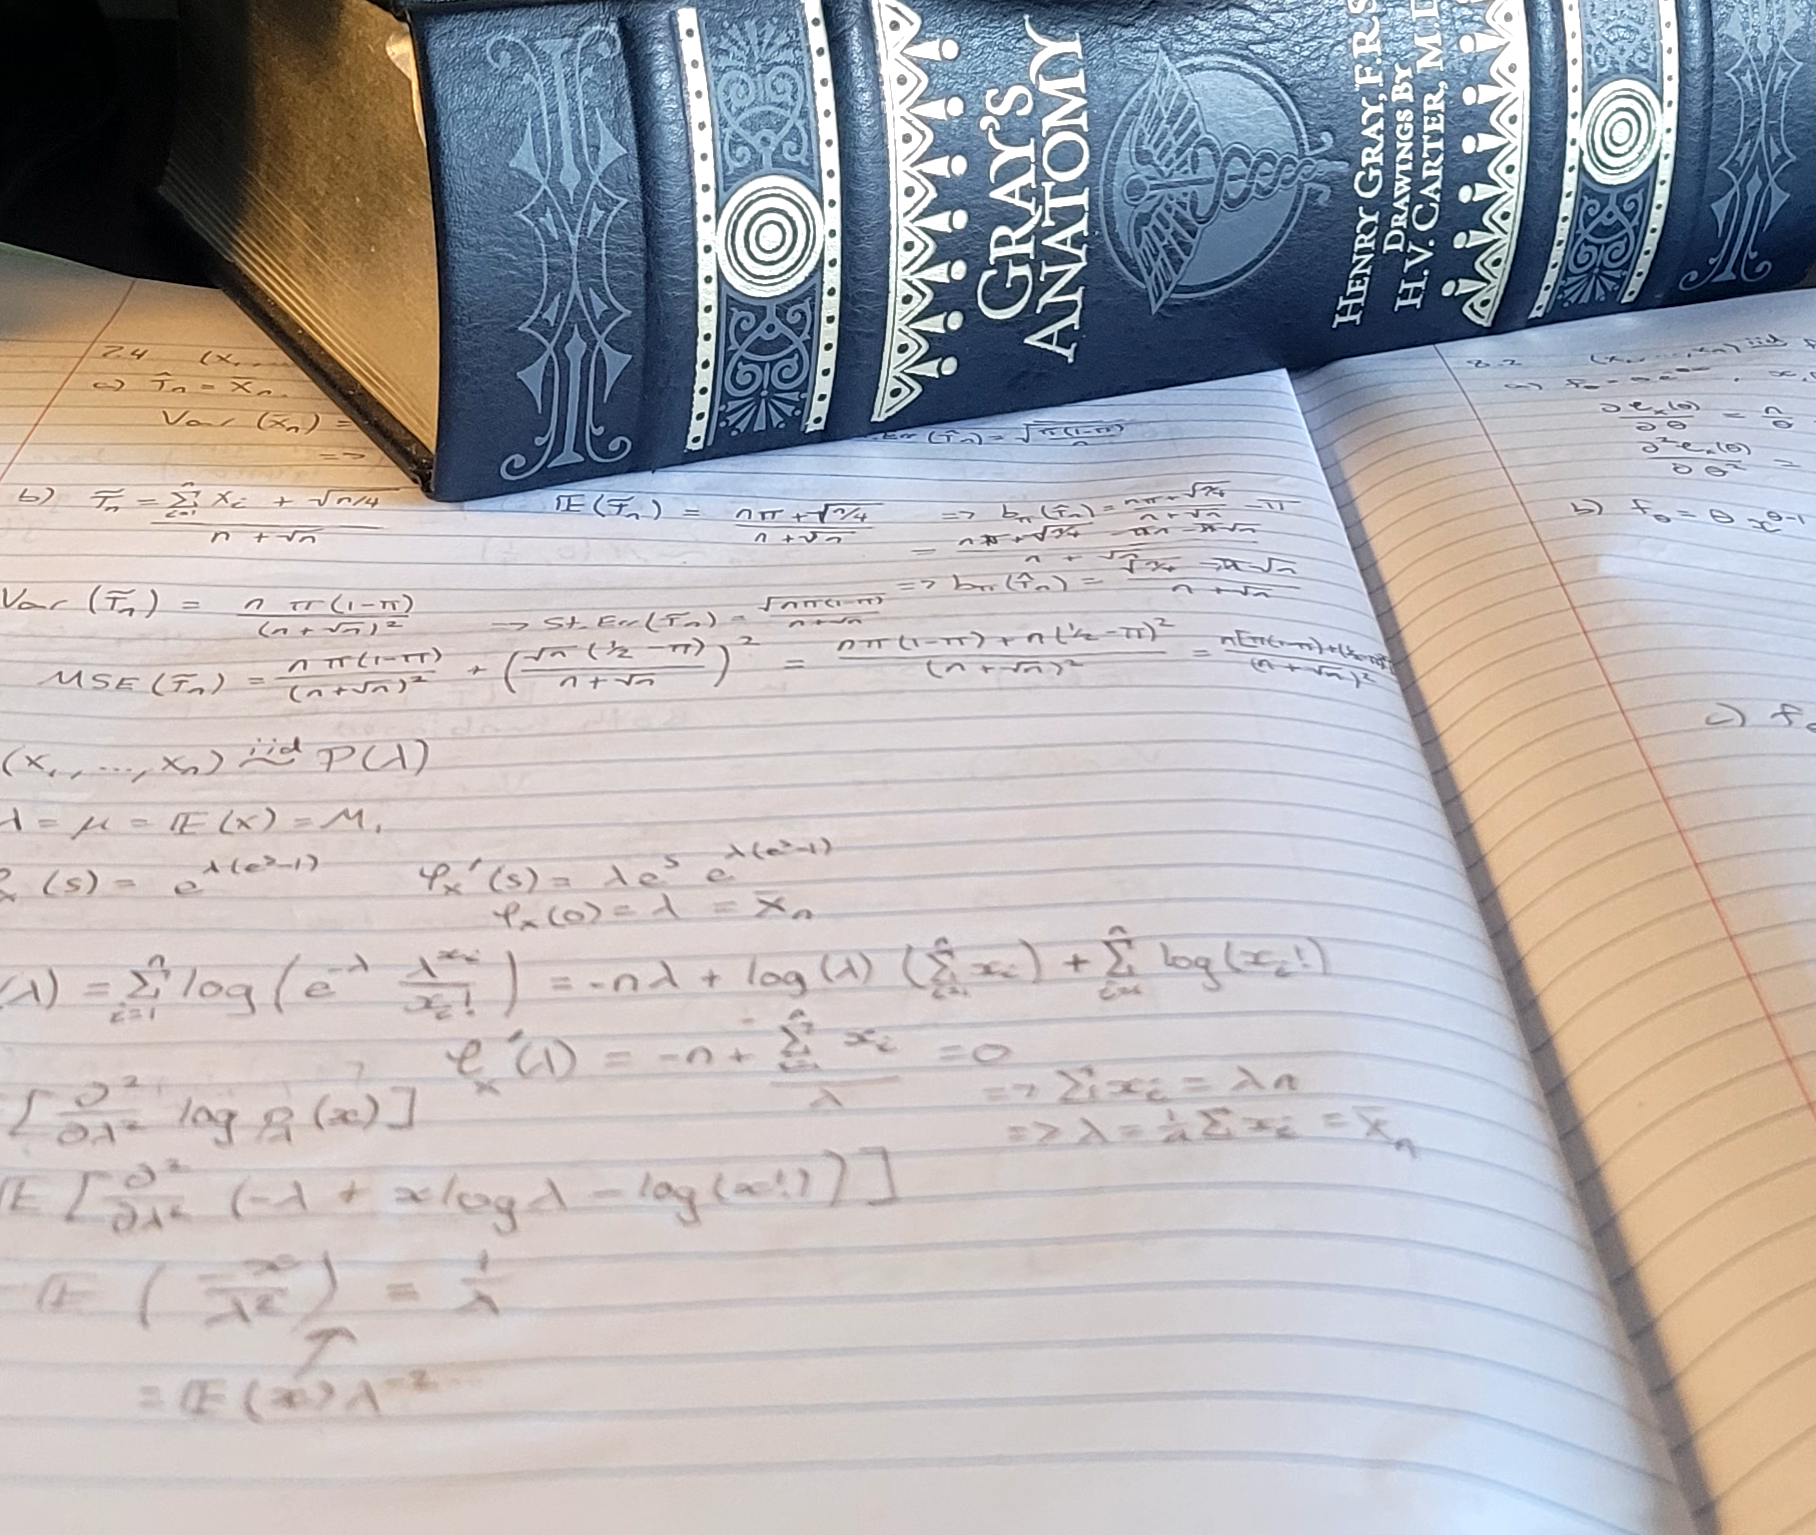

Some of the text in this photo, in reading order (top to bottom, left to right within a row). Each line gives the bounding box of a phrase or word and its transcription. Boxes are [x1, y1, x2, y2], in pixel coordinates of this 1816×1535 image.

[976, 84, 1037, 319] GRAY'S
[1024, 13, 1092, 363] ANATOMY
[1353, 92, 1387, 198] GRAY,
[1382, 109, 1414, 253] DRAWINGS
[1411, 81, 1448, 232] CARTER,
[1331, 206, 1381, 329] HENRY
